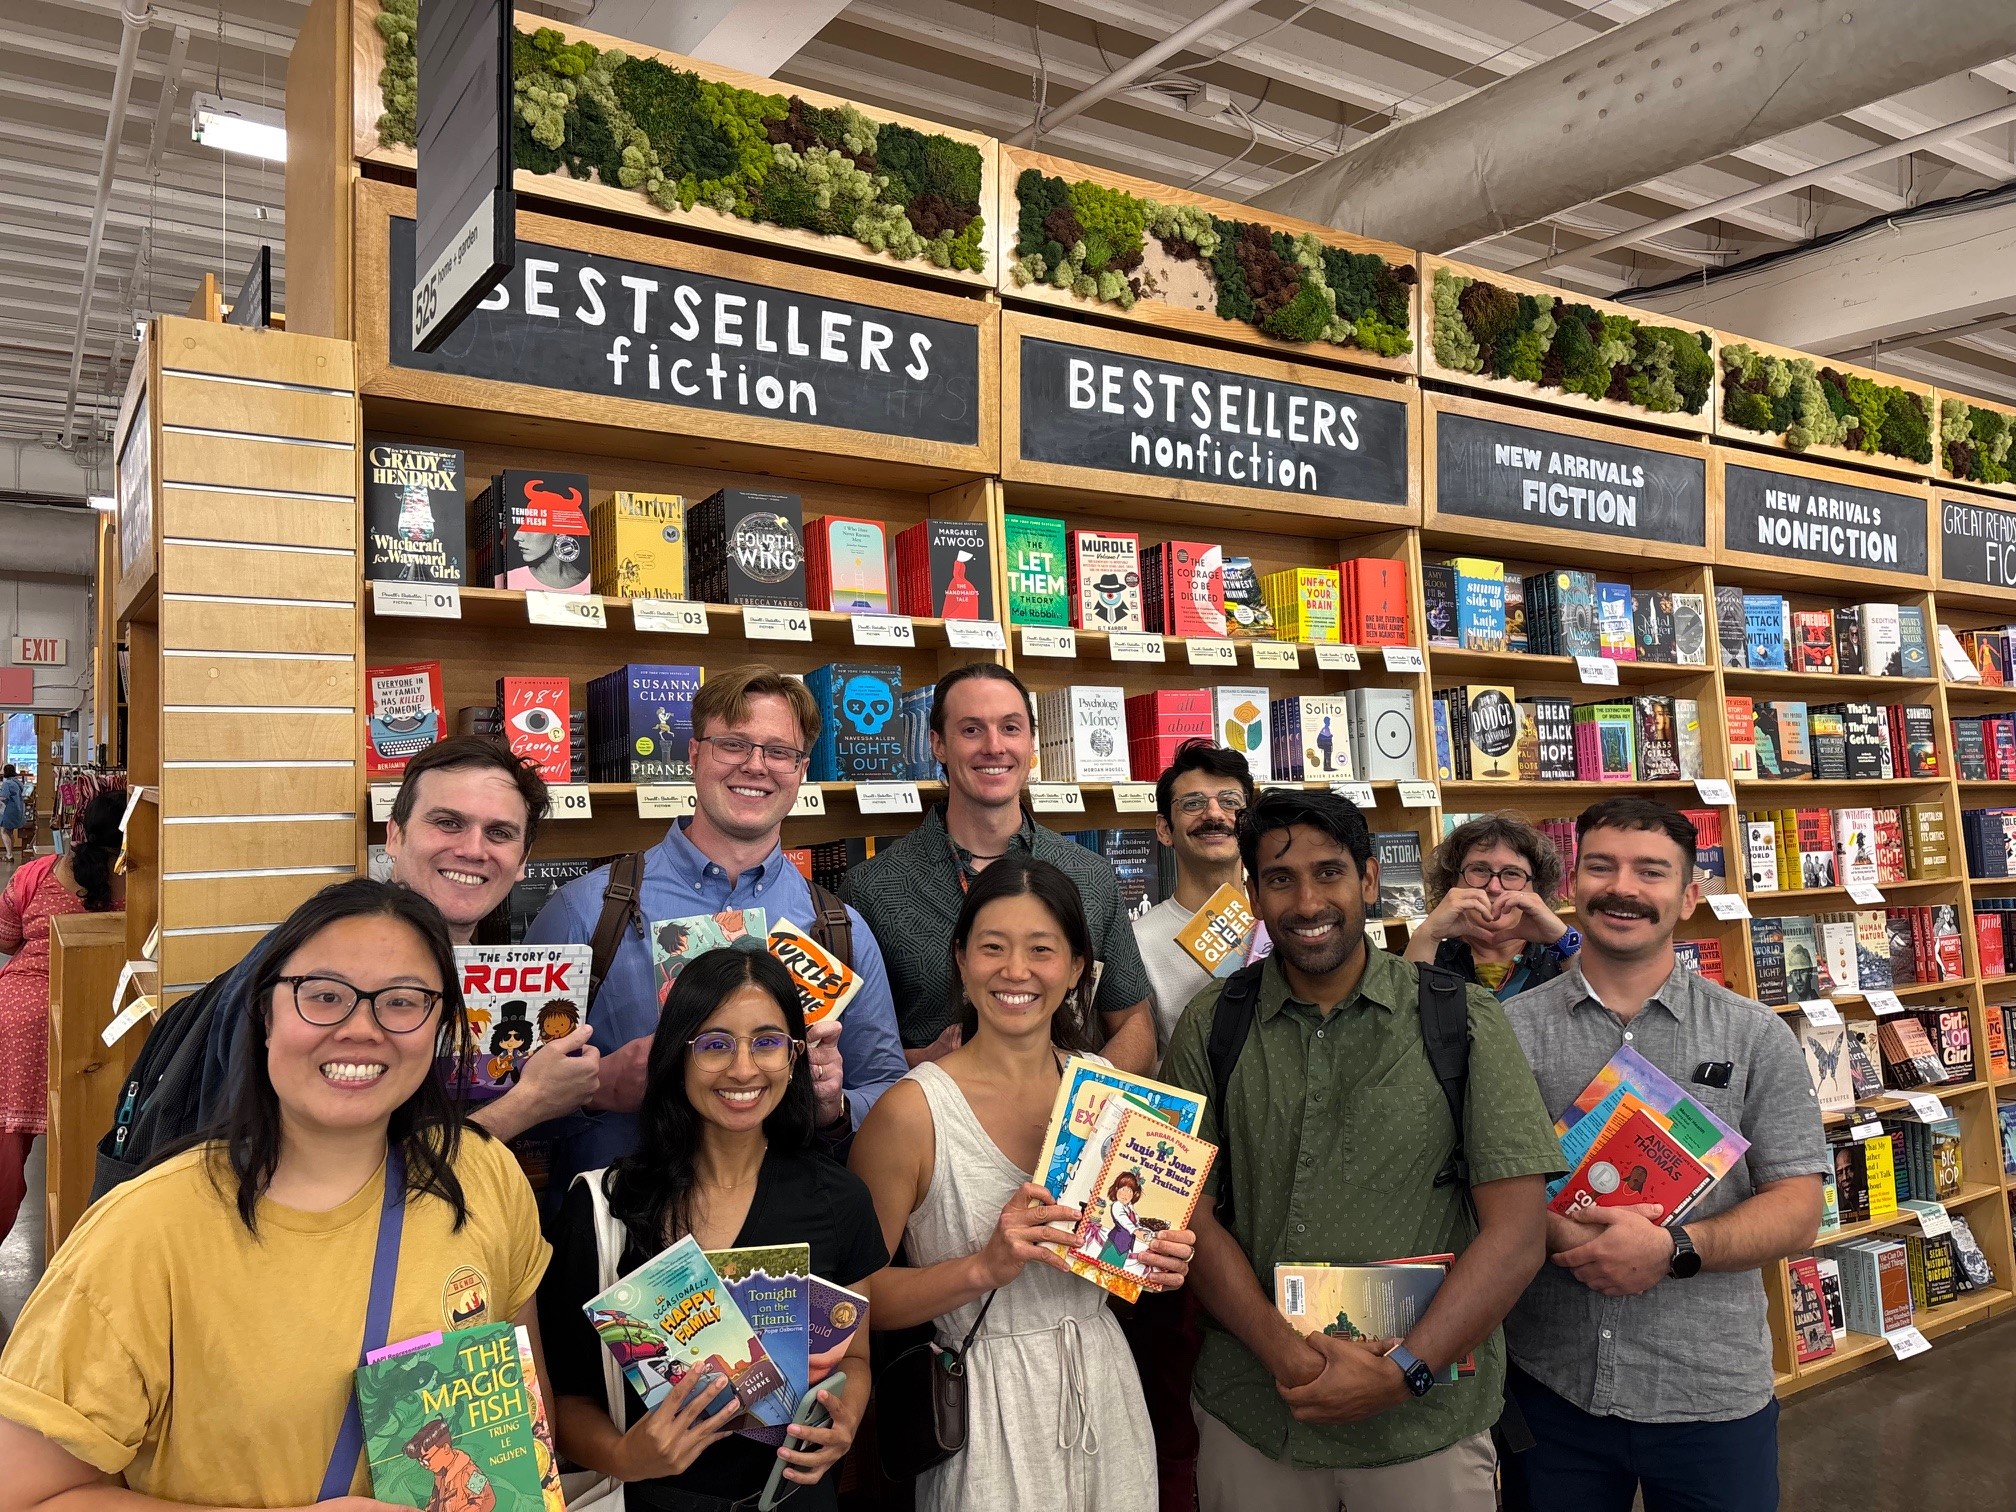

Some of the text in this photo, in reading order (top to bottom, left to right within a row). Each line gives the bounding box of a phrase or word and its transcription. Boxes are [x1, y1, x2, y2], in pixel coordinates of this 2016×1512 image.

[437, 225, 479, 286] home garden
[415, 273, 438, 336] 525
[606, 335, 819, 417] fiction
[1068, 358, 1360, 452] BESTSELLERS
[369, 446, 440, 472] GRADY
[1130, 431, 1318, 492] nonfiction
[1494, 443, 1645, 488] NEW ARRIVALS
[373, 467, 457, 492] HENDRIX
[618, 492, 682, 524] Martyr!
[1521, 478, 1637, 528] FICTION
[1765, 489, 1882, 527] NEW ARRIVALS
[511, 507, 548, 518] TENDER IS
[511, 516, 547, 527] THE FLESH
[1943, 504, 1984, 538] GREAT
[938, 528, 978, 536] MARGARET
[374, 534, 443, 553] Witchcraft
[736, 531, 794, 550] FOURTH
[933, 536, 985, 548] ATWOOD
[1027, 540, 1043, 549] THE
[1081, 539, 1134, 554] MURDLE
[1757, 515, 1899, 564] NONFICTION
[372, 549, 447, 567] for Wayward
[737, 547, 796, 571] WING
[1018, 550, 1054, 572] LET
[1191, 557, 1205, 568] THE
[430, 565, 461, 580] Girls
[1177, 568, 1220, 580] COURAGE
[1007, 572, 1065, 596] THEM
[1188, 581, 1211, 591] TO BE
[1300, 577, 1337, 589] UNF#CK
[1424, 580, 1447, 588] BLOOM
[1466, 582, 1502, 598] sunny
[621, 585, 683, 600] Kaveh Akbar
[1181, 592, 1218, 603] DISLIKED
[1306, 588, 1331, 599] YOUR
[434, 594, 453, 608] 01
[734, 597, 770, 607] REBECCA
[1020, 595, 1054, 605] THEORY
[1306, 600, 1333, 610] BRAIN
[1466, 594, 1502, 611] side up
[580, 605, 600, 619] 02
[683, 613, 702, 625] 03
[1011, 607, 1063, 620] Mel Robbins
[789, 619, 807, 631] 04
[1473, 613, 1497, 628] katie
[1745, 615, 1780, 627] ATTACK
[894, 626, 910, 638] 05
[1467, 627, 1503, 640] sturino
[1746, 632, 1781, 645] WITHIN
[22, 638, 58, 662] EXIT
[1059, 637, 1071, 649] 01
[1147, 642, 1161, 654] 02
[1220, 647, 1233, 658] 03
[1283, 651, 1295, 661] 04
[1344, 652, 1356, 663] 05
[1411, 655, 1422, 666] 06
[377, 677, 424, 689] EVERYONE IN
[633, 679, 699, 690] SUSANNA
[395, 687, 421, 696] FAMILY
[512, 689, 564, 707] 1984
[640, 691, 693, 702] CLARKE
[381, 694, 425, 706] HAS KILLED
[1079, 697, 1119, 711] Psychology
[384, 704, 423, 715] SOMEONE
[1305, 702, 1342, 716] Solito
[1537, 704, 1570, 720] GREAT
[1846, 703, 1872, 714] That's
[1080, 711, 1120, 731] Money
[1472, 703, 1513, 733] DODGE
[1862, 714, 1878, 723] How
[1168, 720, 1205, 732] about
[1538, 724, 1572, 740] BLACK
[1848, 723, 1869, 734] They
[1849, 734, 1879, 745] Get You
[510, 734, 561, 762] George
[839, 742, 902, 755] LIGHTS
[1540, 745, 1574, 761] HOPE
[631, 762, 694, 776] PIRANES
[853, 757, 889, 770] OUT
[902, 792, 914, 804] 11
[1065, 793, 1078, 804] 07
[1361, 790, 1370, 800] 11
[1427, 789, 1436, 799] 12
[564, 795, 586, 808] 08
[803, 796, 819, 807] 10
[1918, 811, 1944, 822] CAPITALISM
[1106, 847, 1151, 856] Emotionally
[1379, 844, 1422, 864] ASTORIA
[1110, 857, 1147, 865] Immature
[541, 866, 589, 878] KUANG
[1194, 900, 1244, 952] GENDER
[1204, 910, 1255, 963] QUEER
[1860, 931, 1885, 941] NATURE
[478, 950, 562, 963] THE STORY OF
[1762, 956, 1780, 967] FIRST
[769, 931, 851, 1000] TURTLES
[463, 962, 571, 995] ROCK
[1759, 968, 1780, 979] LIGHT
[1939, 1012, 1962, 1031] Girl
[1943, 1046, 1971, 1065] Girl
[1834, 1094, 1850, 1103] KUPER
[1146, 1131, 1190, 1154] BARBARA PARK
[1125, 1137, 1197, 1175] Junie B. Jones
[1633, 1134, 1683, 1181] THOMAS
[1645, 1134, 1684, 1168] ANGIE
[1941, 1149, 1956, 1167] BIG
[1119, 1152, 1165, 1175] and the Yucky
[1892, 1130, 1910, 1199] SPECTRUM
[1939, 1168, 1960, 1187] HOP
[1151, 1174, 1190, 1197] Fruitcake
[1928, 1267, 1952, 1281] BIGFOOT
[653, 1277, 710, 1320] OCCASIONALLY
[655, 1294, 666, 1307] AN
[747, 1287, 797, 1303] Tonight
[659, 1287, 718, 1334] HAPPY
[759, 1303, 790, 1312] on the
[673, 1305, 722, 1347] FAMILY
[751, 1312, 797, 1327] Titanic
[458, 1336, 515, 1373] THE
[744, 1370, 764, 1387] CLIFF
[421, 1362, 519, 1415] MAGIC
[746, 1376, 771, 1396] BURKE
[468, 1388, 523, 1428] FISH
[488, 1421, 520, 1438] TRUNG
[501, 1437, 512, 1449] LE
[489, 1446, 528, 1467] NGUYEN
